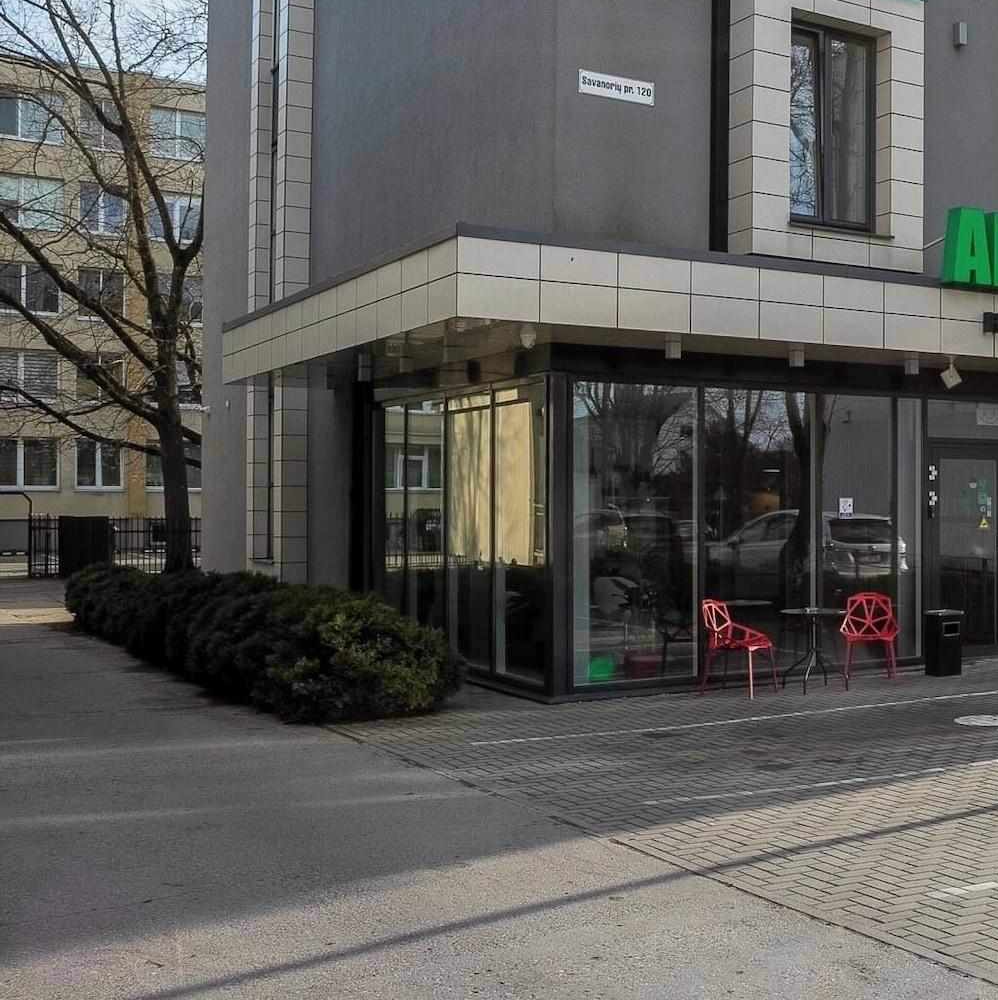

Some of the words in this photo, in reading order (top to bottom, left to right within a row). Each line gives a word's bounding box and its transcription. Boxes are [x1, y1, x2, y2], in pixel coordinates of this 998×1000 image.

[581, 75, 621, 94] Savanorių
[624, 85, 634, 94] pr.
[637, 86, 652, 97] 120
